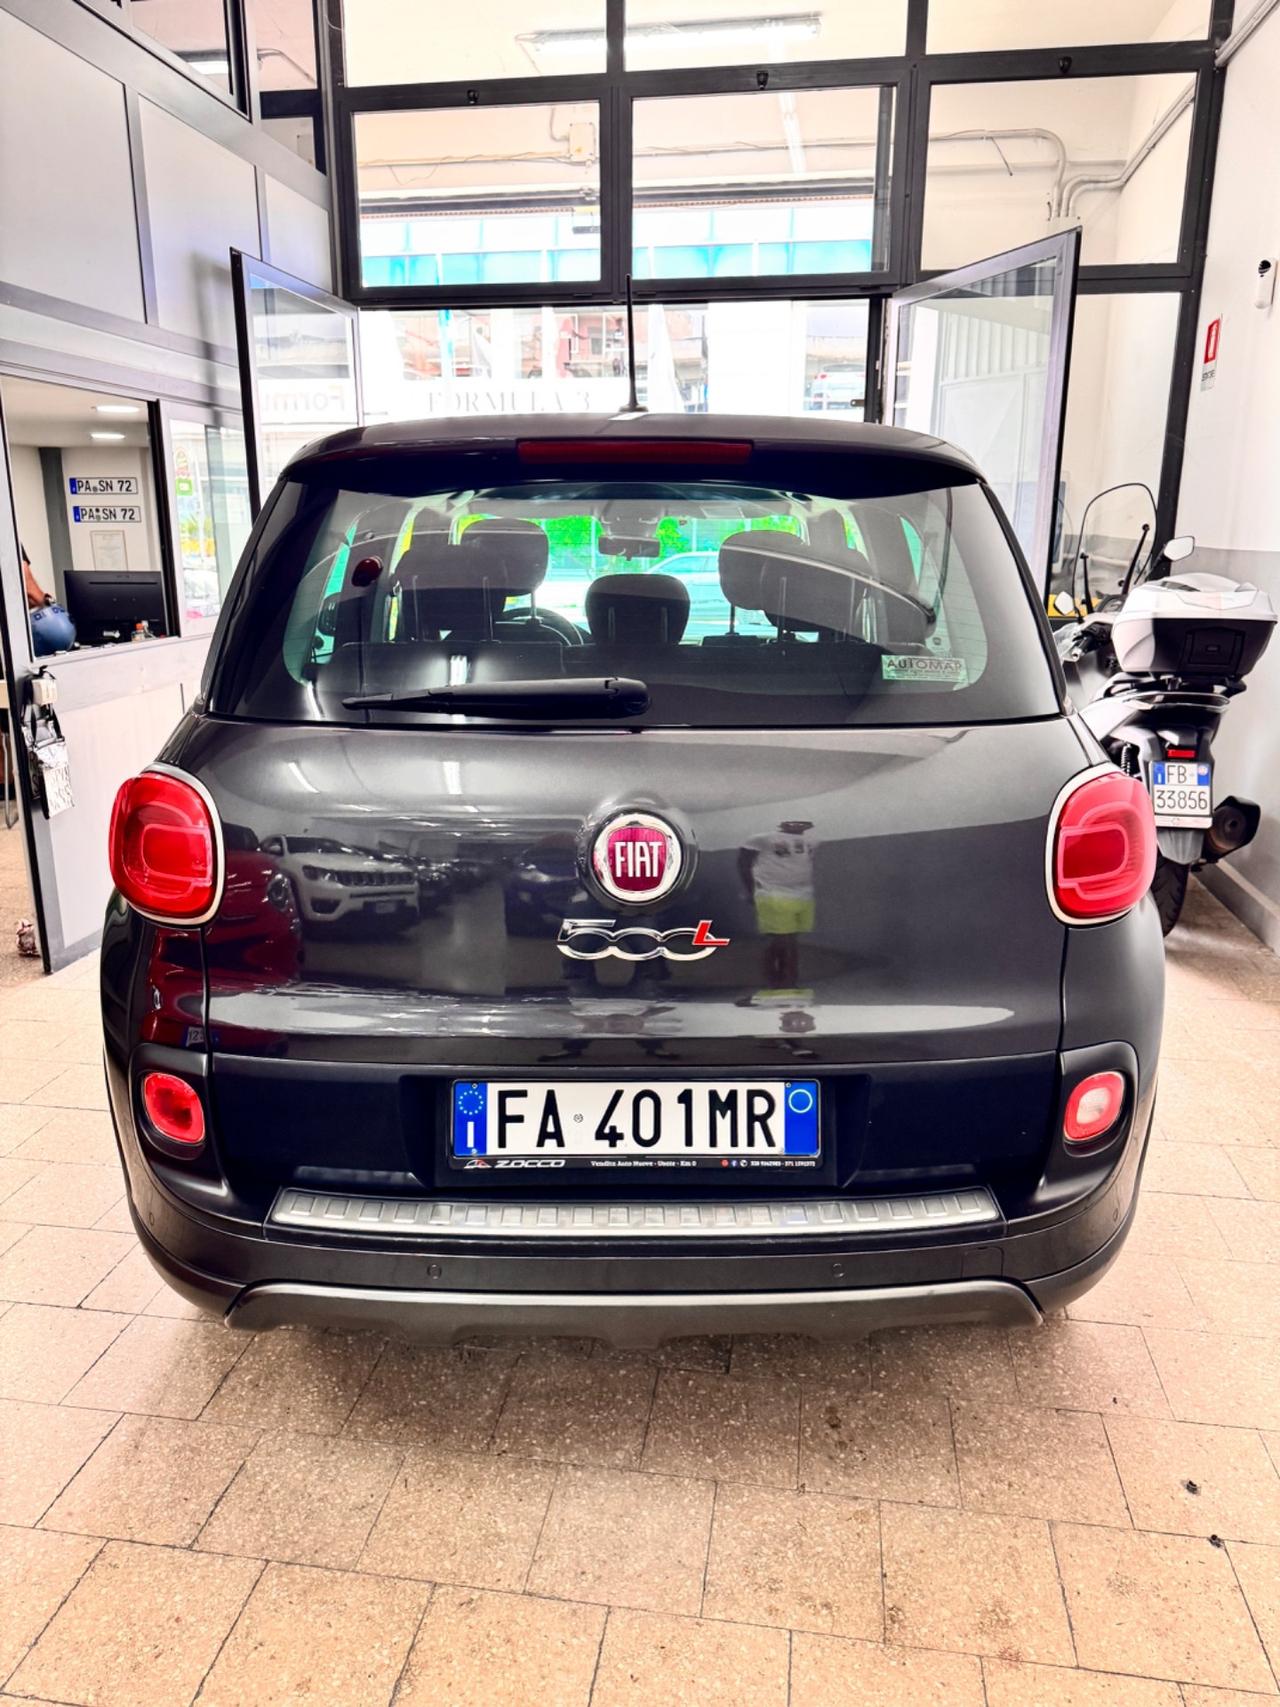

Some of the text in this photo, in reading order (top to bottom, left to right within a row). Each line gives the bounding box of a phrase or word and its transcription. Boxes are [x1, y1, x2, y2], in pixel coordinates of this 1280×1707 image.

[77, 480, 132, 492] PA SN 72
[81, 508, 135, 520] PA SN 72
[1167, 764, 1187, 784] FB
[1156, 789, 1208, 810] 33856
[614, 841, 664, 878] FIAT
[497, 1088, 777, 1149] FA 401MR
[494, 1159, 566, 1169] ZOCCO
